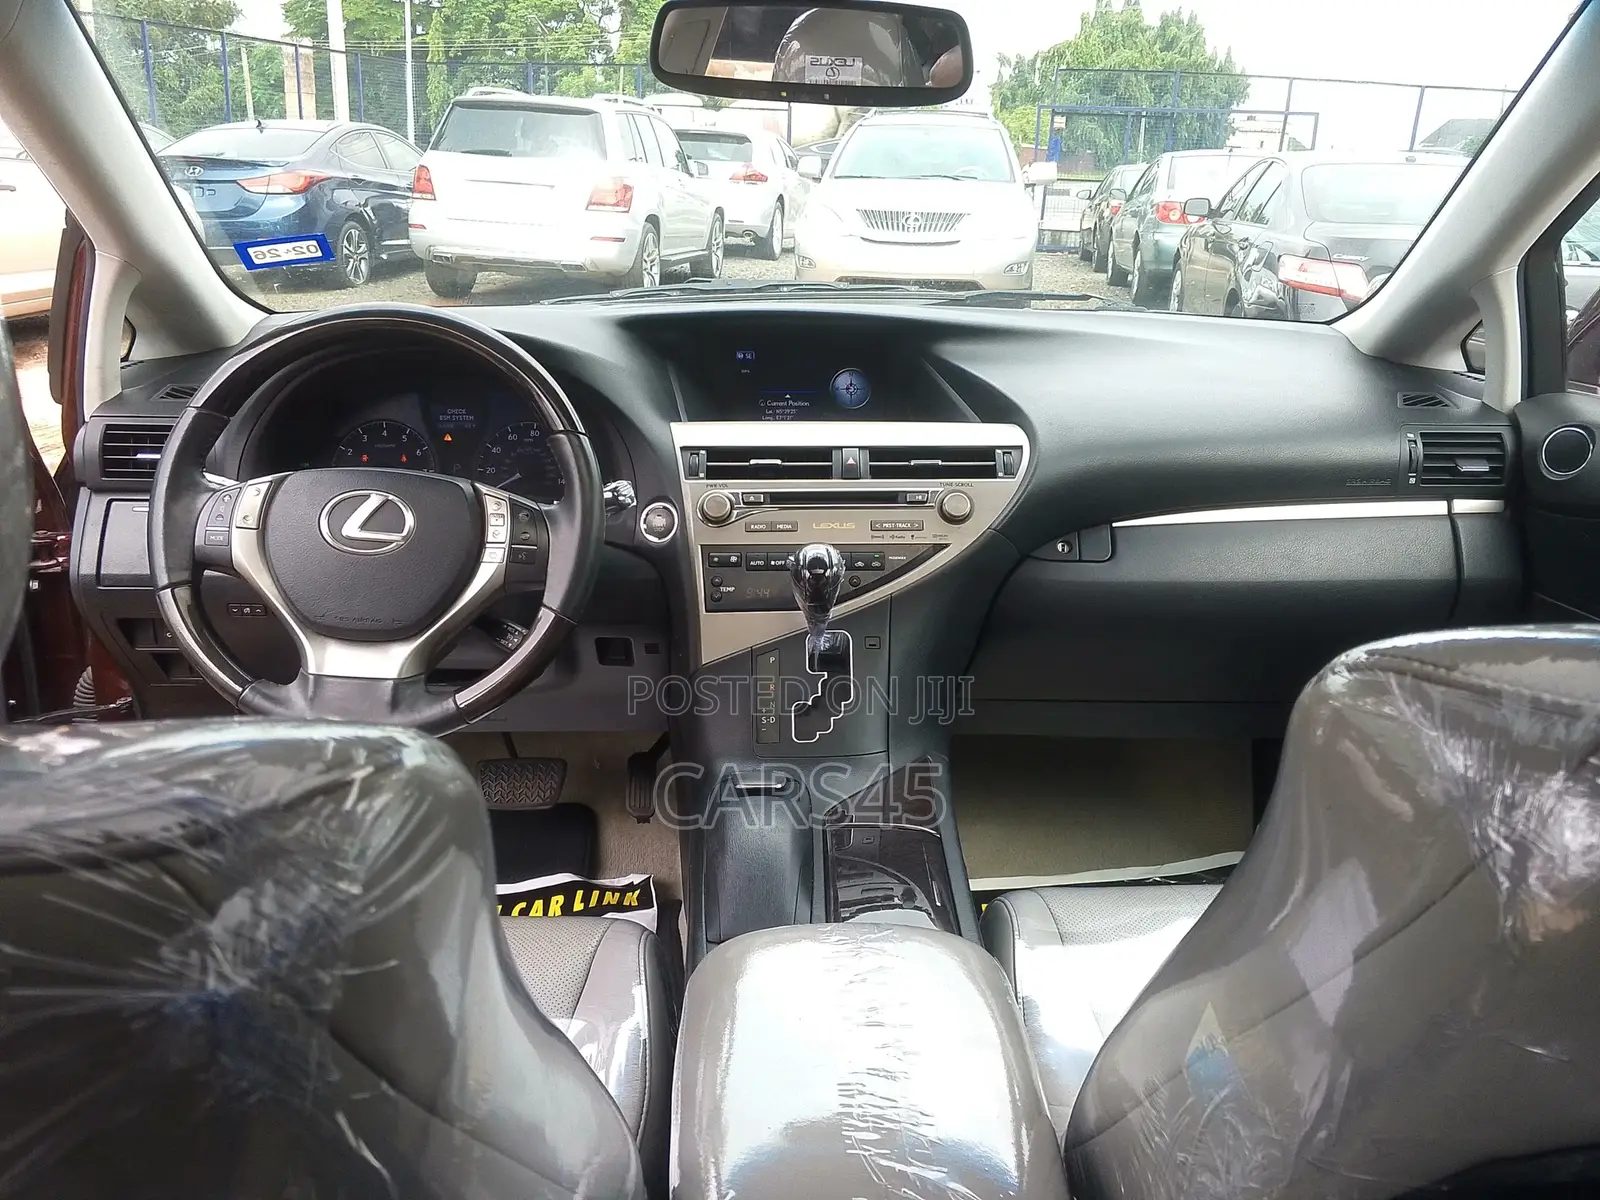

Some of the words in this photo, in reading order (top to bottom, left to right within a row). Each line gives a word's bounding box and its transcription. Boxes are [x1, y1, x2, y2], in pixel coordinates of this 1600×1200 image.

[381, 429, 388, 437] 4
[507, 433, 518, 441] 60
[362, 434, 368, 442] 3
[402, 434, 408, 442] 5
[347, 448, 353, 456] 2
[491, 446, 502, 454] 40
[812, 522, 856, 530] LEXUS
[769, 656, 776, 664] P
[511, 895, 564, 917] CAR
[573, 889, 641, 912] LINK
